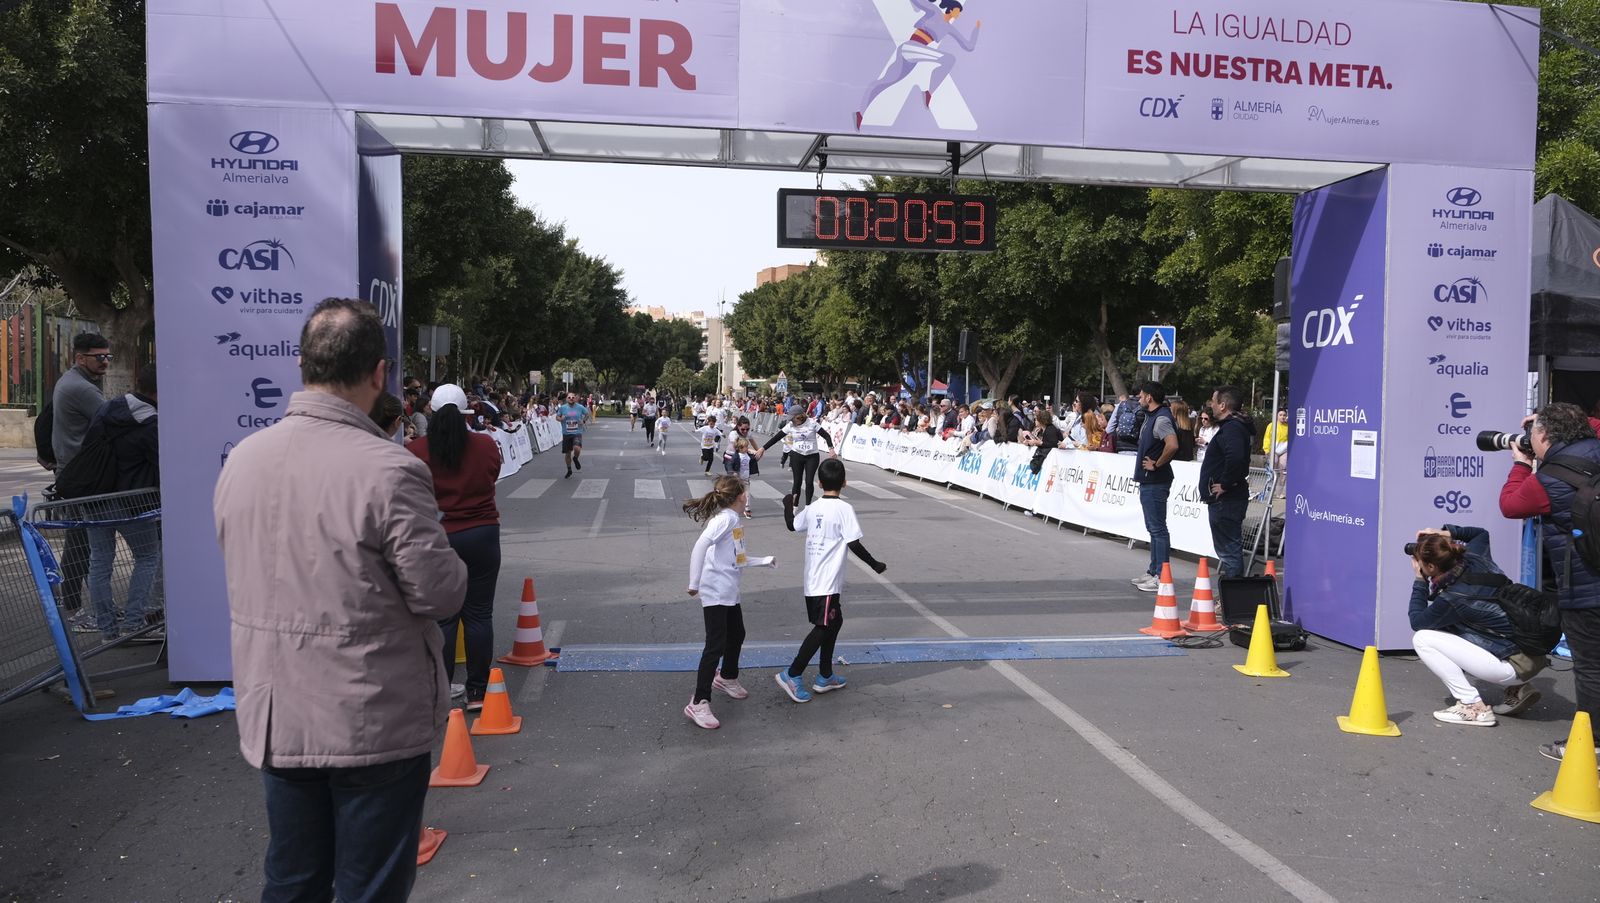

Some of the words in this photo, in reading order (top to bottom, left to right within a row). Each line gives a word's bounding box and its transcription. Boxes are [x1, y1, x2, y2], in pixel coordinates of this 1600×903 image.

[1173, 10, 1206, 36] LA
[1215, 13, 1352, 46] IGUALDAD
[375, 2, 697, 90] MUJER
[1127, 49, 1163, 75] ES
[1170, 51, 1303, 85] NUESTRA
[1309, 62, 1393, 90] META.
[1233, 100, 1283, 114] ALMERÍA
[1233, 112, 1259, 121] CIUDAD
[211, 158, 299, 171] HYUNDAI
[223, 172, 289, 184] Almerialva
[234, 201, 305, 218] cajamar
[1433, 209, 1494, 221] HYUNDAI
[815, 196, 985, 245] 00:20:53
[1440, 221, 1487, 232] Almerialva
[218, 246, 279, 271] CASI
[1447, 245, 1497, 260] cajamar
[240, 288, 303, 304] vithas
[1433, 283, 1478, 304] CASI
[1302, 300, 1358, 348] CDX
[1447, 318, 1492, 332] vithas
[229, 340, 301, 360] aqualia
[1436, 362, 1489, 378] aqualia
[1313, 406, 1367, 424] ALMERÍA
[1313, 426, 1339, 435] CIUDAD
[1437, 423, 1471, 435] Clece
[1456, 455, 1484, 478] CASH
[1104, 474, 1140, 495] ALMER
[1101, 492, 1126, 506] CIUDAD
[1433, 490, 1471, 513] ego
